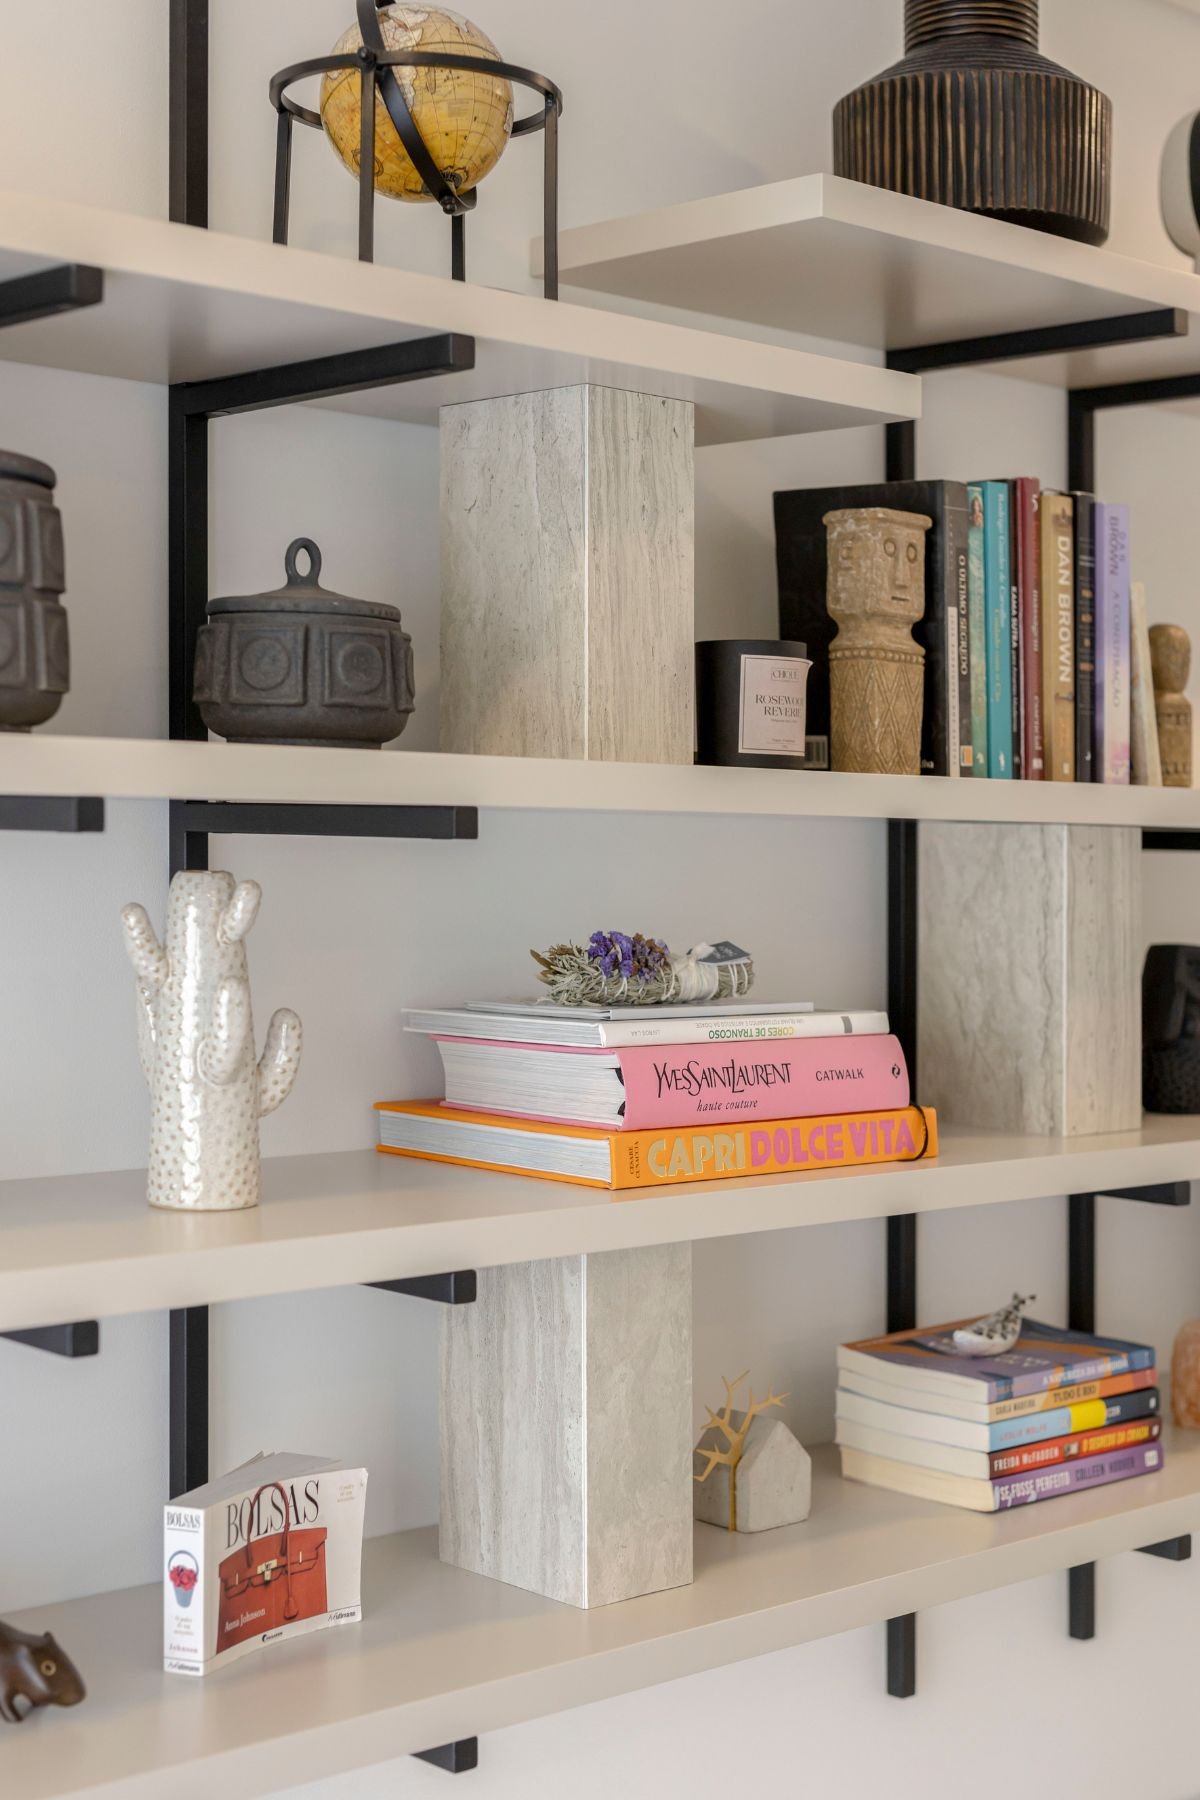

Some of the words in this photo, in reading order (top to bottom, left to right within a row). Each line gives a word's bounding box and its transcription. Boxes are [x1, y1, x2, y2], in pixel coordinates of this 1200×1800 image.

[1109, 515, 1120, 577] BROWN
[1057, 535, 1071, 586] DAN
[1010, 585, 1018, 615] KAMA
[1011, 617, 1019, 648] SUTRA
[1058, 593, 1072, 683] BROWN
[959, 617, 969, 676] SEGREDO
[755, 694, 804, 706] ROSEWOO
[708, 1027, 754, 1040] TRANCOSO
[755, 1027, 766, 1038] DE
[767, 1026, 795, 1037] CORES
[815, 1068, 865, 1082] CATWALK
[696, 1099, 722, 1112] haute
[725, 1099, 759, 1111] couture
[647, 1131, 747, 1178] CAPRI
[750, 1123, 845, 1168] DOLCE
[848, 1118, 917, 1158] VITA
[1053, 1389, 1075, 1403] TUDO
[1083, 1384, 1097, 1397] RIO
[994, 1456, 1020, 1472] FREIDA
[1036, 1470, 1071, 1492] PERFEITO
[1075, 1462, 1106, 1482] COLLEEN
[166, 1511, 201, 1529] BOLSAS
[225, 1479, 320, 1550] BOLSAS
[224, 1620, 240, 1633] Anna
[239, 1608, 266, 1626] Johnson
